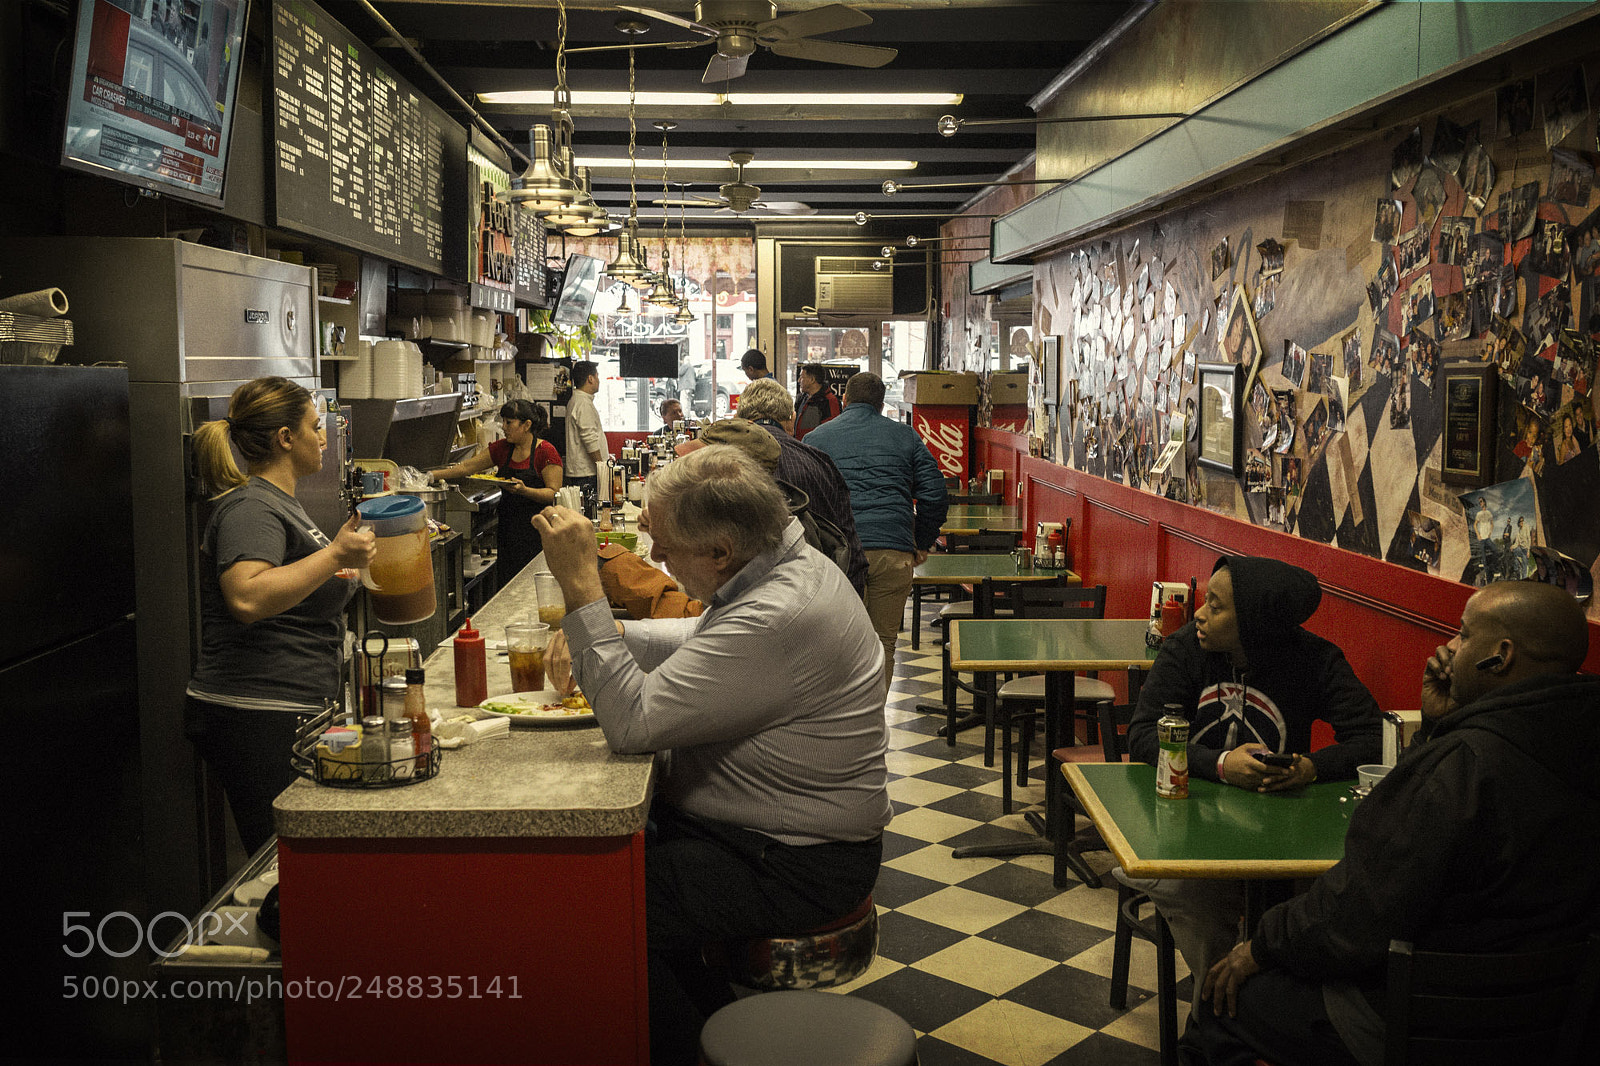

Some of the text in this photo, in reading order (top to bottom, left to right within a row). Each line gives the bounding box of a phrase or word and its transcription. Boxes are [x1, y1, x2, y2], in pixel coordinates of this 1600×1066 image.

[478, 289, 511, 311] DINER
[828, 369, 849, 379] We're
[373, 665, 403, 678] Coke
